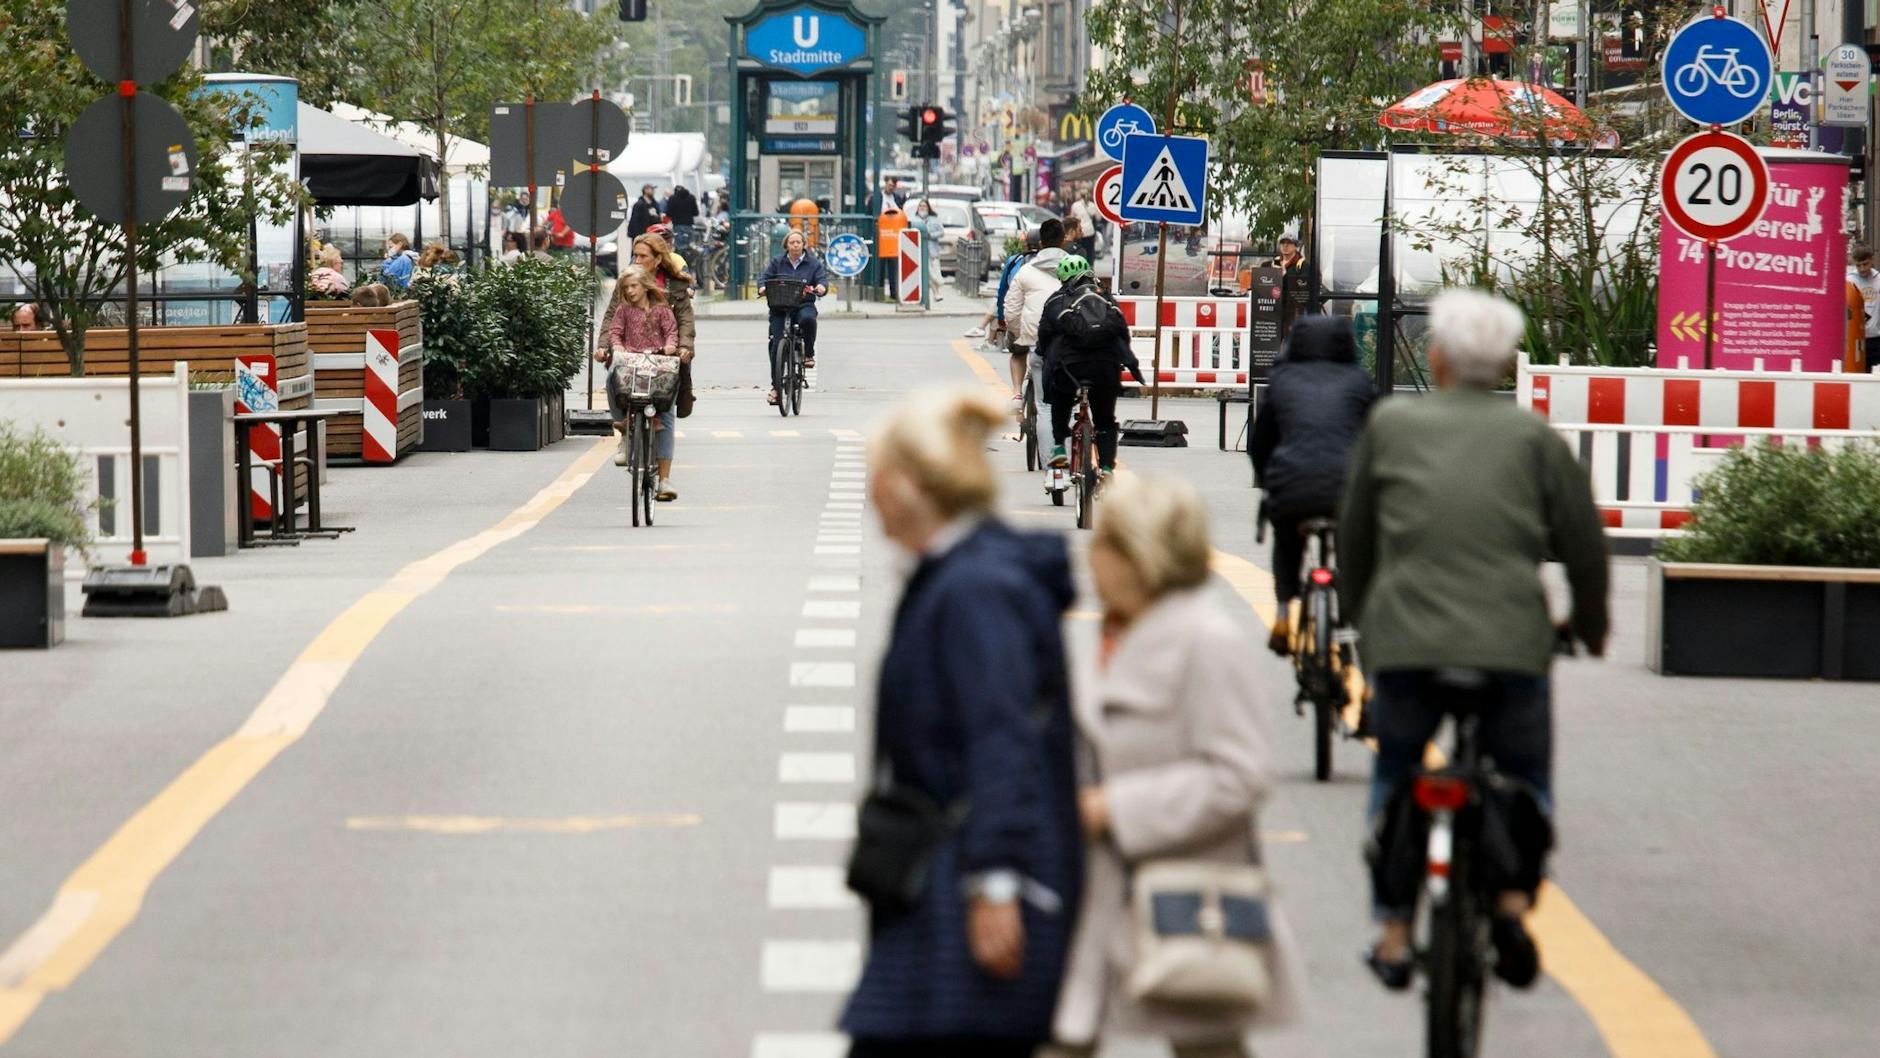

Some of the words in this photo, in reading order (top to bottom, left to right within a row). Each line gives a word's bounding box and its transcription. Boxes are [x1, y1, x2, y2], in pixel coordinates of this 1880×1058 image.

[793, 15, 819, 48] U
[770, 49, 842, 63] Stadtmitte
[1841, 50, 1855, 60] 30
[1688, 163, 1742, 206] 20
[1677, 238, 1704, 264] 74
[144, 306, 209, 320] Zgaretten
